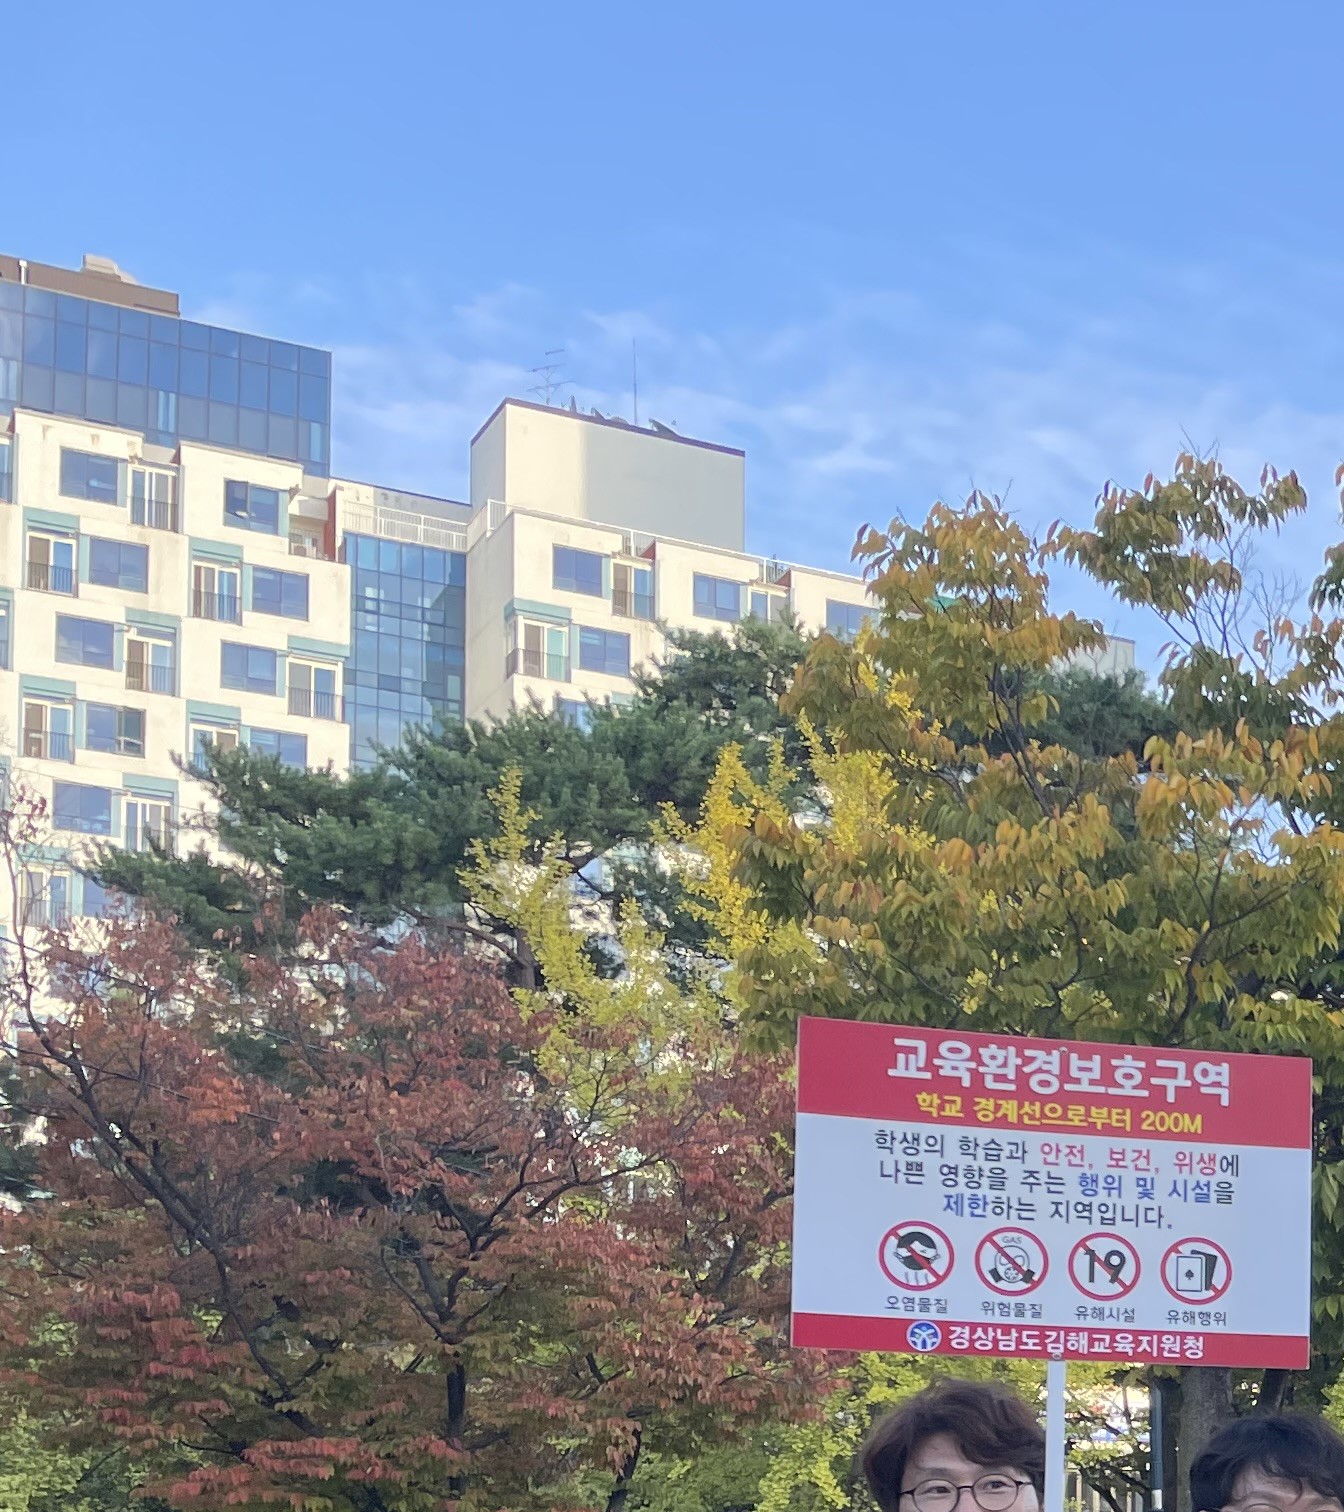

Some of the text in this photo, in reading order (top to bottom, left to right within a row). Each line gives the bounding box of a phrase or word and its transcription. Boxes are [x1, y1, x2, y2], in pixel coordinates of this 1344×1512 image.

[887, 1036, 1231, 1107] 교육환경보호구역
[915, 1092, 1203, 1135] 학교 경계선으로부터 200M
[874, 1129, 1241, 1178] 학생의 학습과 안전, 보건, 위생에
[879, 1159, 1237, 1206] 나쁜 영향을 주는 행위 및 시설을
[942, 1191, 1174, 1231] 제한하는 지역입니다.
[884, 1293, 949, 1316] 오염물질
[980, 1301, 1043, 1320] 위험물질
[1073, 1304, 1137, 1324] 유해시설
[1165, 1309, 1228, 1328] 유해행위
[947, 1324, 1205, 1360] 경상남도김해교육지원청
